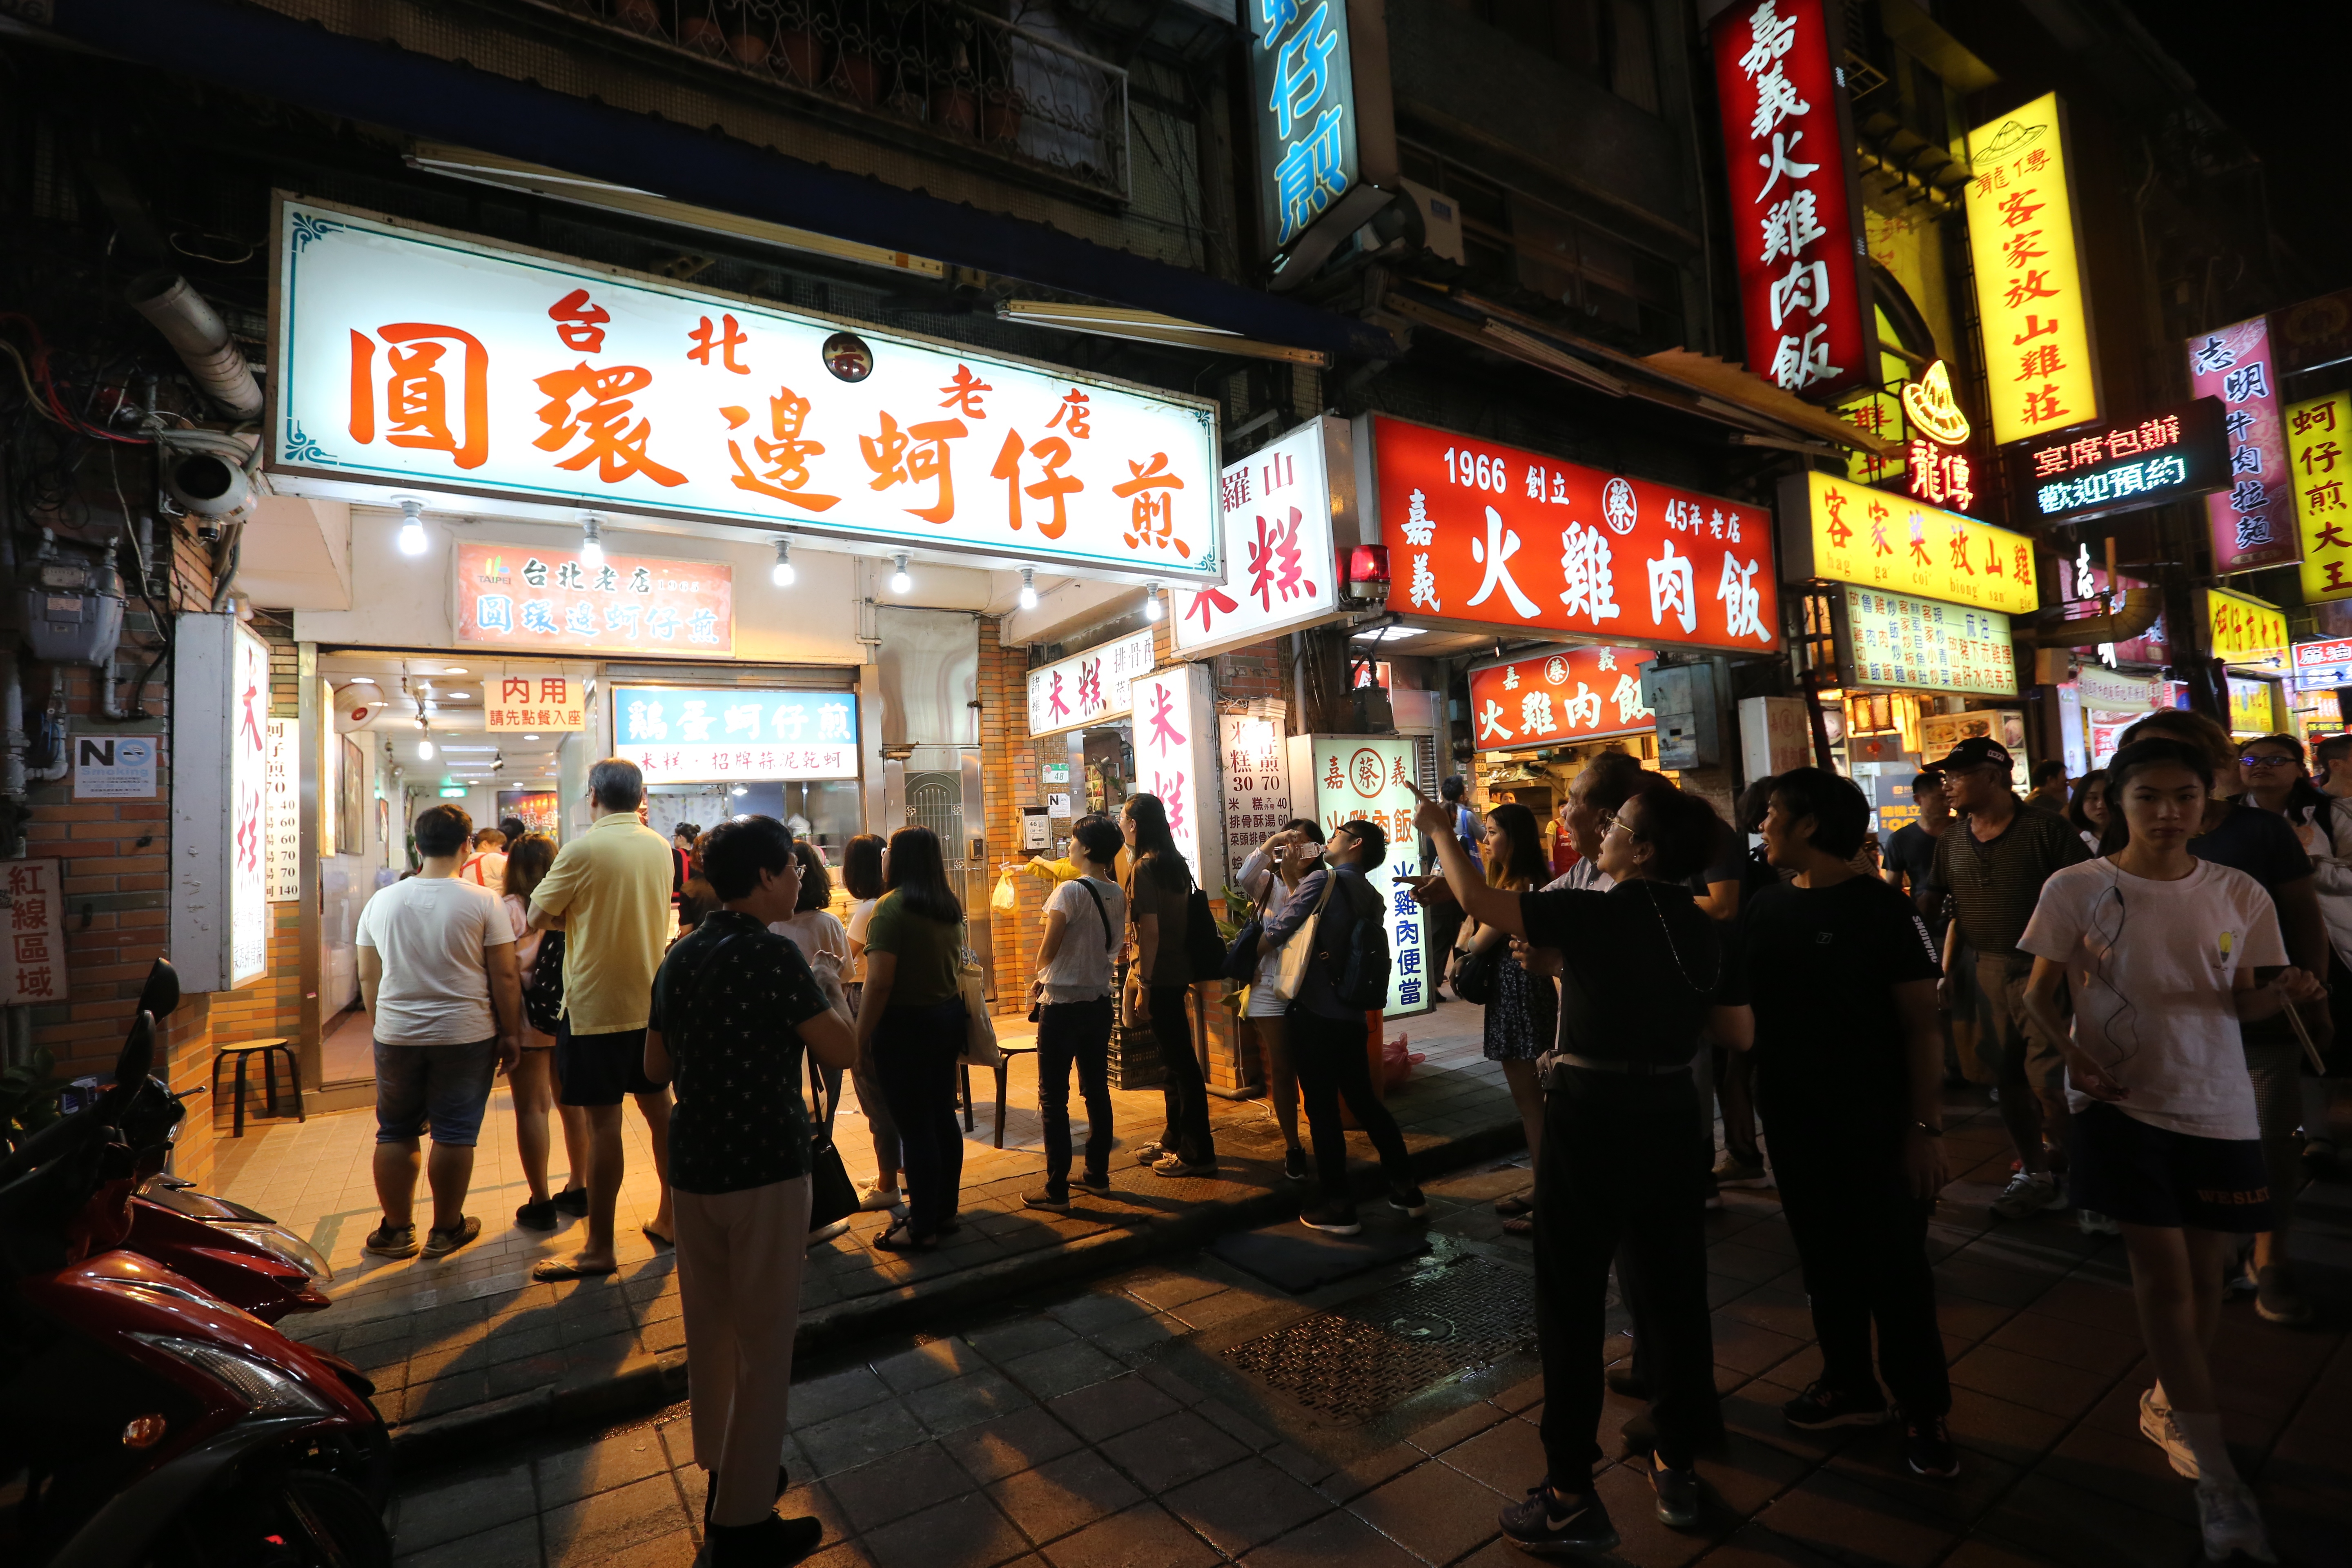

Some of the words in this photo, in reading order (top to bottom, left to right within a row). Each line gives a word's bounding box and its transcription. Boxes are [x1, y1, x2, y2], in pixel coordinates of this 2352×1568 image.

[1739, 0, 1843, 390] 嘉義火雞肉飯
[1976, 148, 2052, 199] 龍傳
[1999, 188, 2070, 425] 客家放山雞莊
[348, 322, 1190, 559] 圓環邊蚵仔煎
[2033, 414, 2180, 477] 宴席包辦
[1444, 447, 1506, 493] 1966
[1525, 465, 1569, 506] 創立
[1910, 439, 1973, 510] 龍傳
[2038, 455, 2186, 514] 歡迎預約
[2292, 401, 2352, 593] 蚵仔煎大王
[1608, 481, 1635, 529] 蔡
[1401, 489, 1440, 612] 嘉義
[1825, 486, 2032, 589] 客家菜放山雞
[478, 575, 511, 585] TAIPEI
[521, 557, 652, 594] 台北老店
[657, 580, 699, 593] 1965
[1467, 506, 1771, 643] 火雞肉飯
[476, 594, 719, 645] 圓環邊蚵仔煎
[503, 677, 566, 704] 內用
[1031, 676, 1041, 732] 諸羅山
[1048, 657, 1107, 726] 米糕
[1481, 675, 1655, 741] 火雞肉飯
[490, 710, 581, 726] 請先點餐入座
[82, 767, 149, 777] Smoking
[1233, 776, 1253, 791] 30
[1261, 776, 1279, 790] 70
[1324, 755, 1345, 789] 嘉
[1391, 756, 1410, 789] 義
[281, 800, 294, 810] 40
[281, 817, 294, 826] 60
[1230, 814, 1275, 828] 排骨酥湯
[1278, 814, 1287, 826] 60
[1278, 797, 1287, 809] 40
[281, 835, 295, 844] 60
[281, 851, 295, 860] 70
[278, 885, 297, 895] 140
[281, 868, 295, 877] 70
[8, 866, 53, 997] 紅線區域
[1393, 861, 1421, 1005] 火雞肉便當
